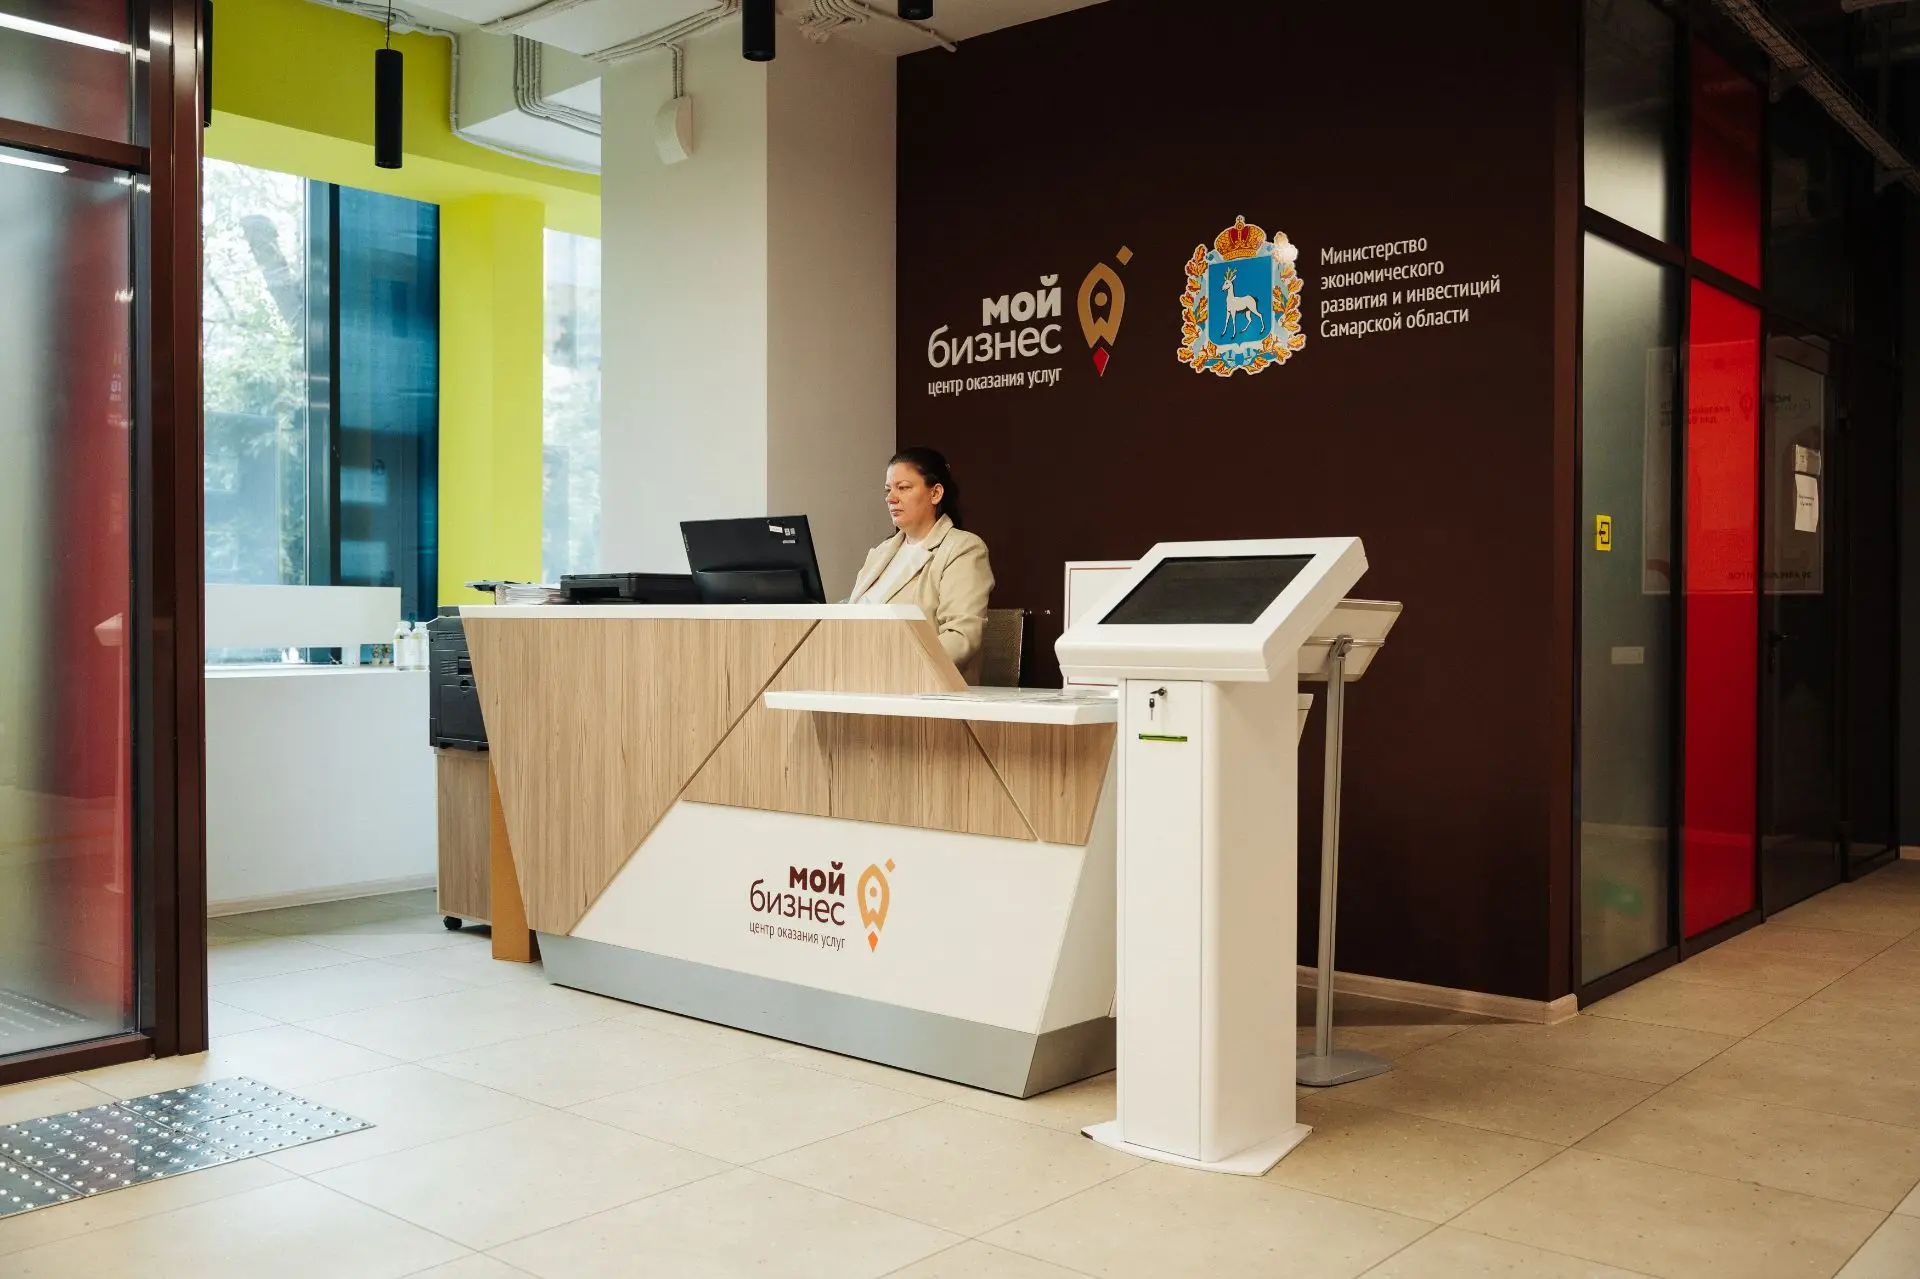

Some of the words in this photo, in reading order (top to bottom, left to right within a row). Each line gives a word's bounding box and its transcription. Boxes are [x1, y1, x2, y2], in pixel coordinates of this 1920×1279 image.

[1321, 237, 1428, 266] Министерство
[1320, 260, 1445, 290] экономического
[982, 274, 1062, 326] мой
[1321, 292, 1388, 318] развития
[1392, 291, 1402, 305] и
[1406, 274, 1501, 303] инвестиций
[1320, 311, 1402, 338] Самарской
[1406, 308, 1469, 329] области
[927, 323, 1063, 368] бизнес
[928, 378, 964, 397] центр
[966, 372, 1025, 391] оказания
[1027, 367, 1063, 389] услуг
[789, 860, 846, 896] мой
[750, 878, 846, 926] бизнес
[749, 921, 775, 939] центр
[777, 926, 819, 944] оказания
[821, 935, 846, 952] услуг
